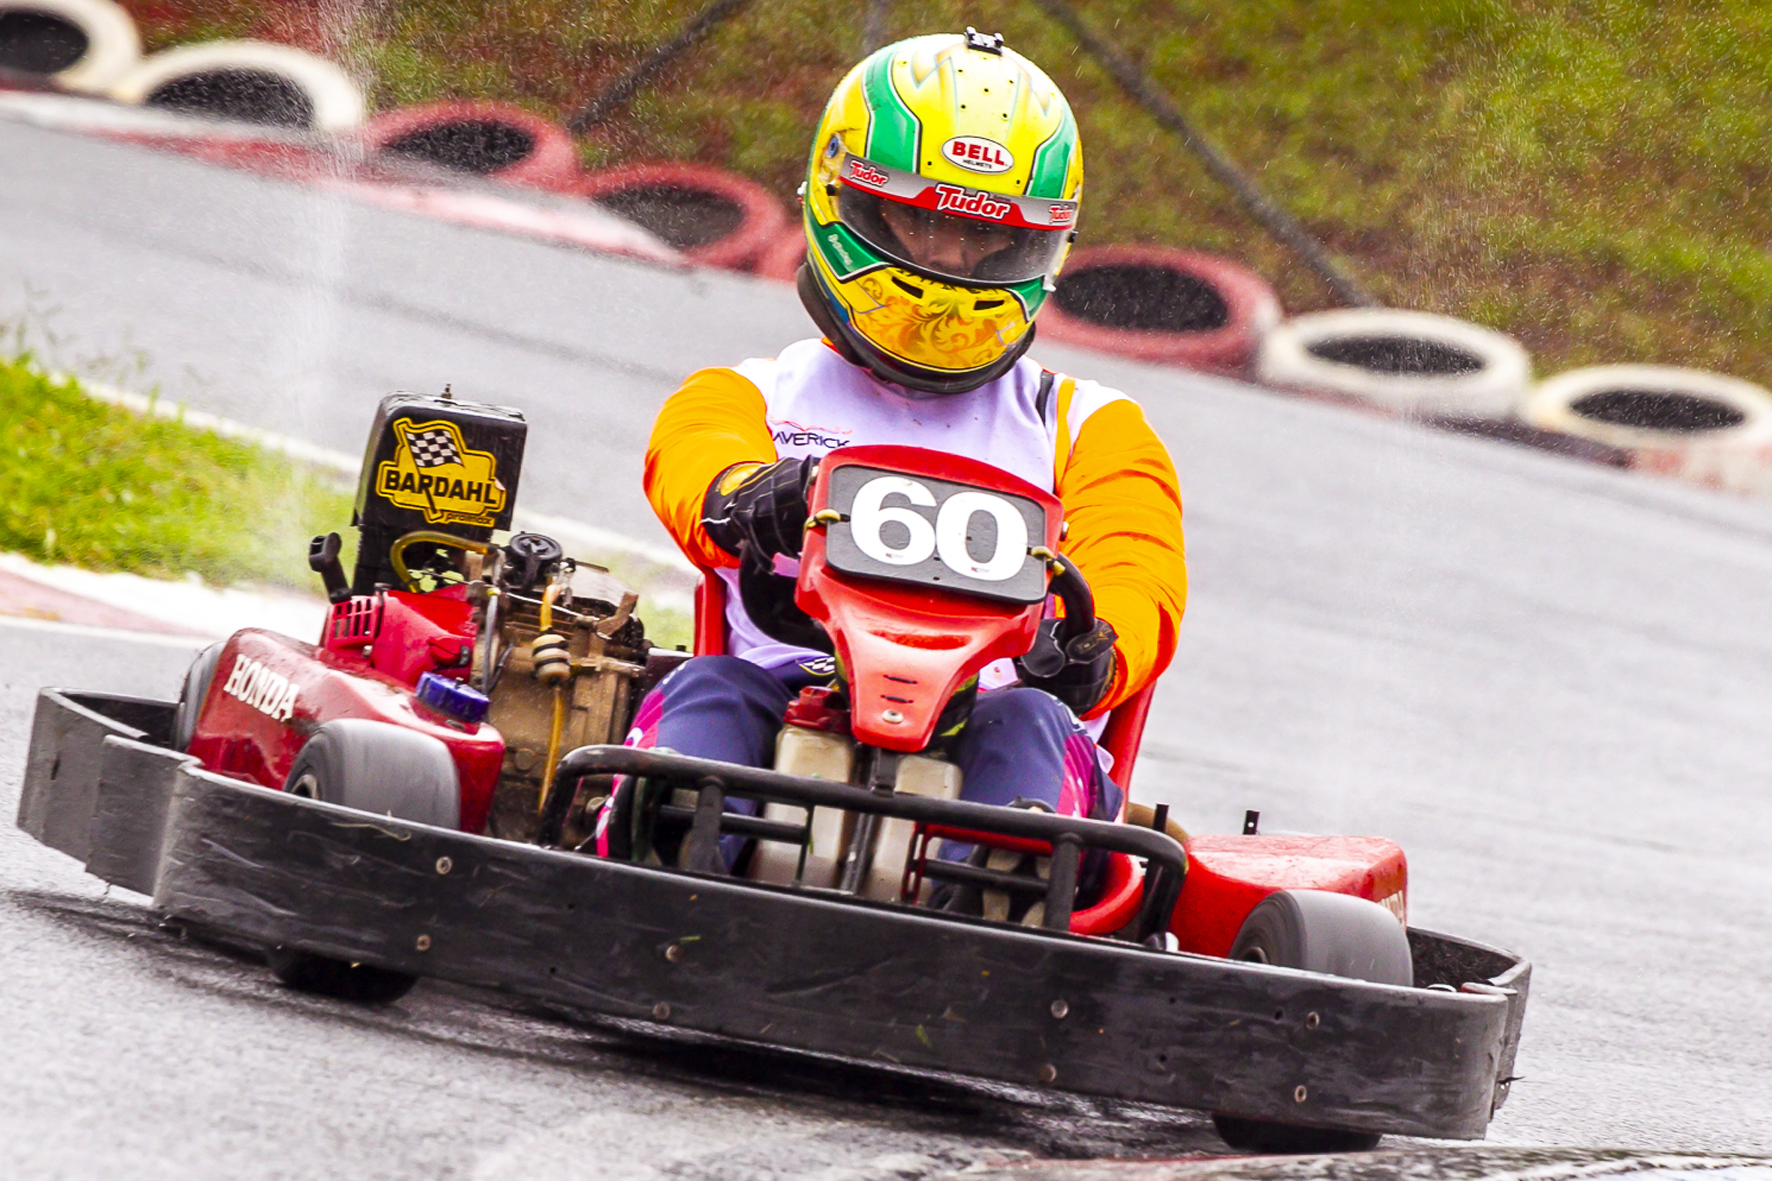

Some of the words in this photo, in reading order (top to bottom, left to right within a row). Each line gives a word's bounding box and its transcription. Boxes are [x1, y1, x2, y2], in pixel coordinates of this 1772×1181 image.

[952, 141, 1005, 166] BELL
[850, 160, 888, 187] Tudor
[936, 184, 1011, 220] Tudor
[773, 431, 850, 449] AVERICK
[385, 470, 497, 504] BARDAHL
[850, 475, 1029, 582] 60
[223, 653, 300, 723] HONDA
